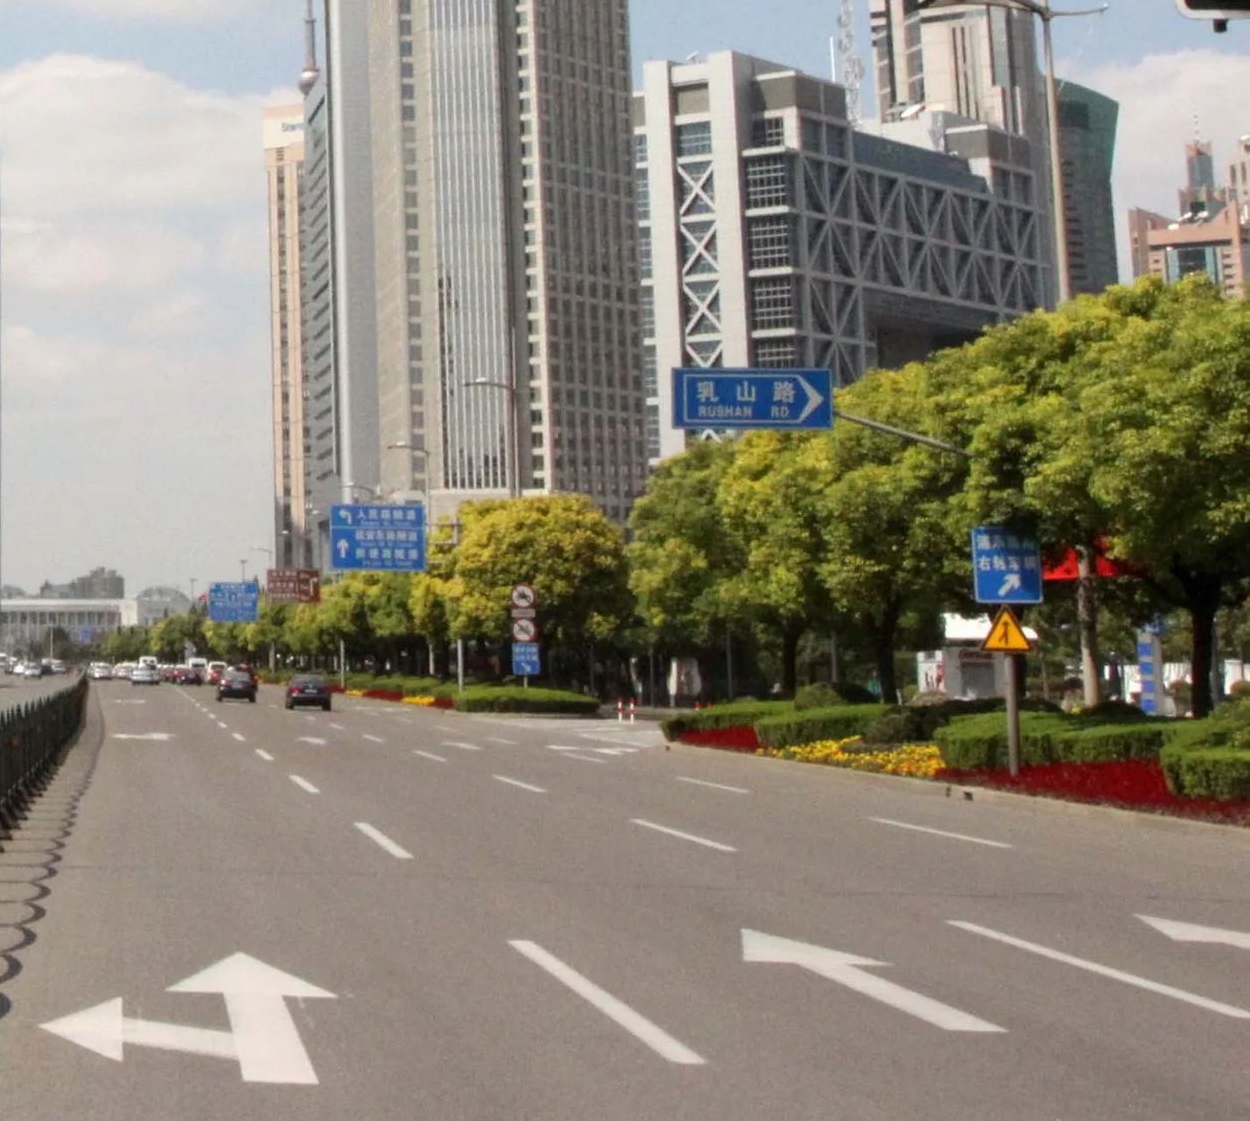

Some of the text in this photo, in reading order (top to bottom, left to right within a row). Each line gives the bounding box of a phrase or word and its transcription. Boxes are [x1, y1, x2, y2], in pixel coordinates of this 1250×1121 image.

[697, 381, 796, 403] 乳山路
[698, 405, 790, 418] RUSHAN RD
